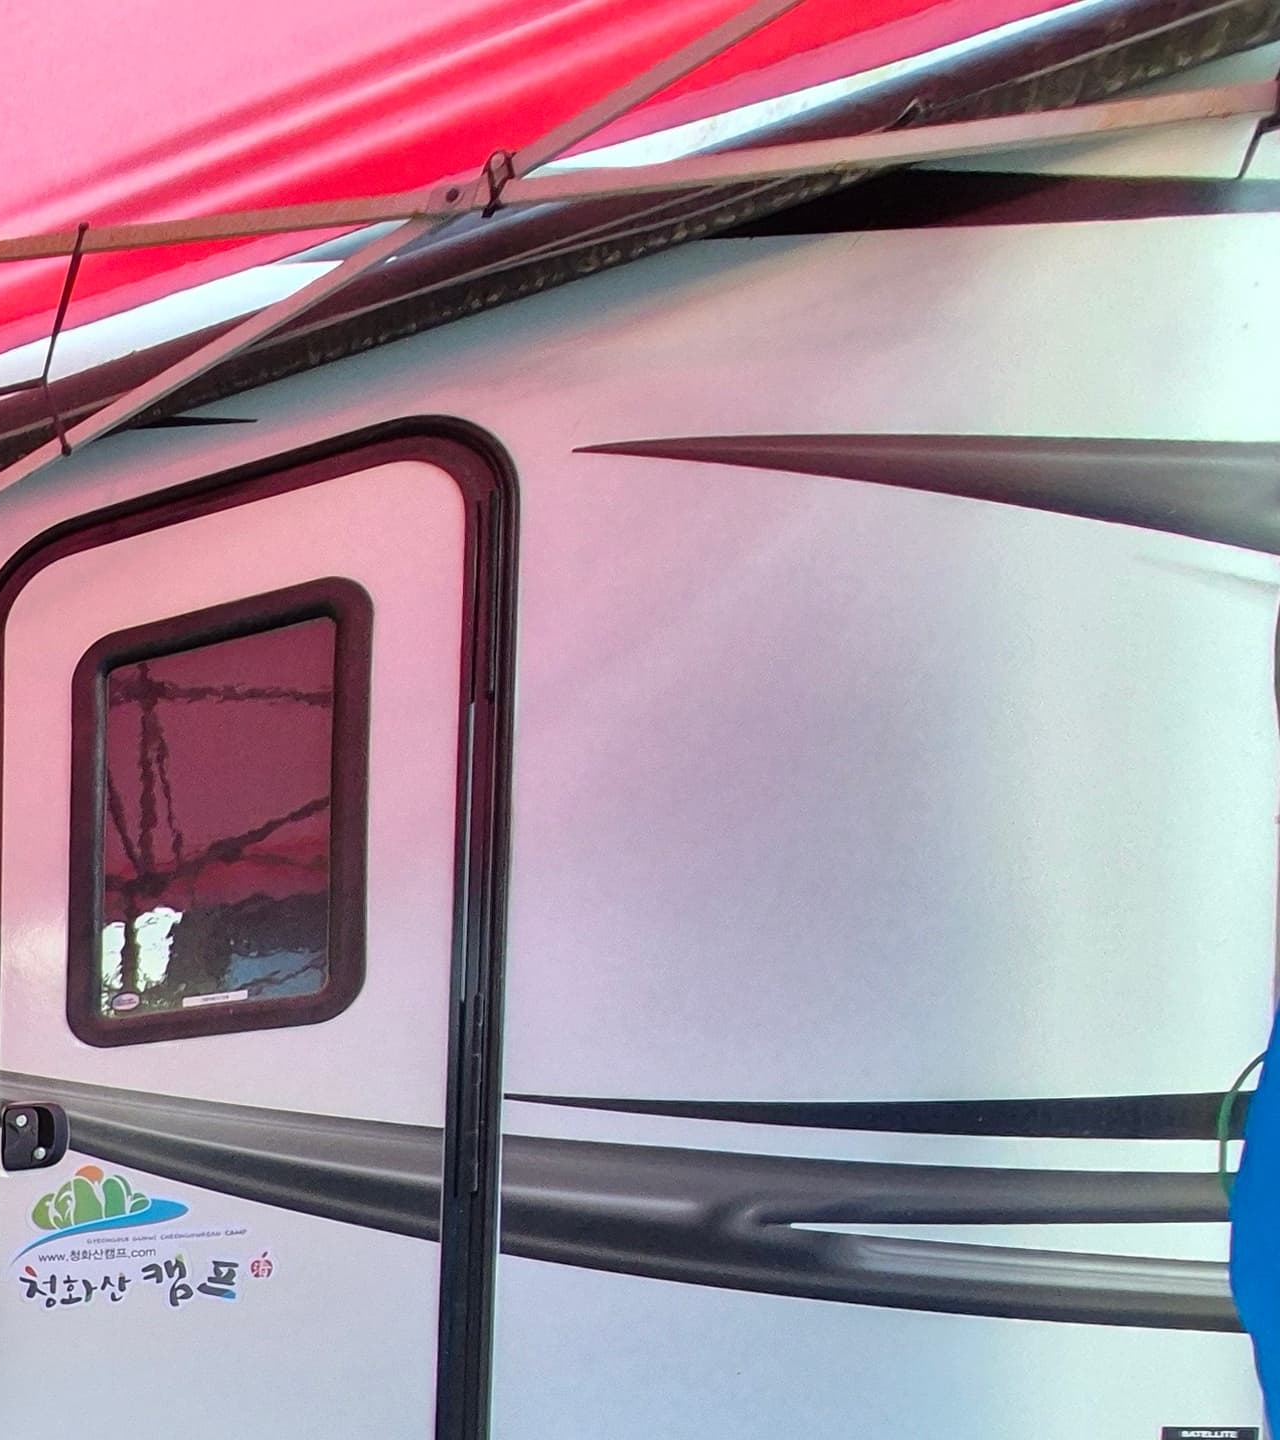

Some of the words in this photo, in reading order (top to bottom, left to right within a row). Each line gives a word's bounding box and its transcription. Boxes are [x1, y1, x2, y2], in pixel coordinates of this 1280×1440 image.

[38, 1247, 156, 1263] www.청화산캠프.com
[19, 1265, 132, 1308] 청화산
[141, 1254, 239, 1307] 캠프
[1181, 1430, 1238, 1439] SATELLITE
